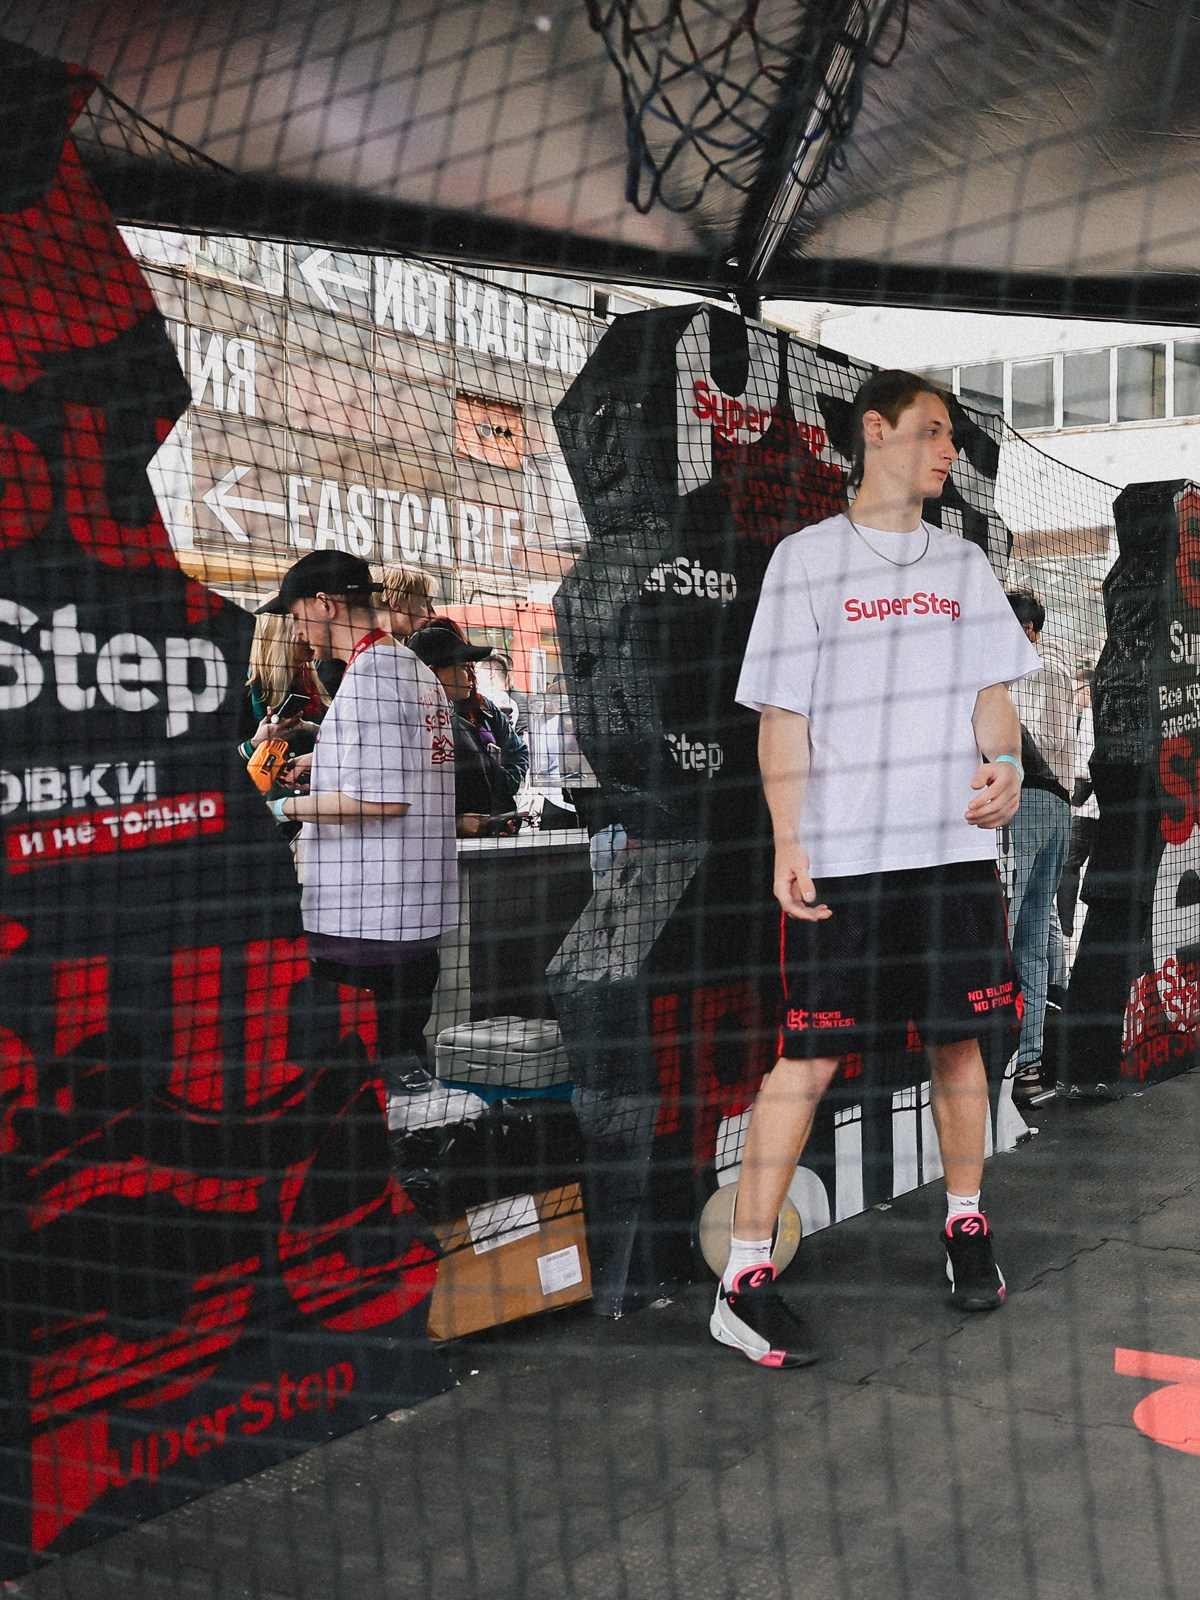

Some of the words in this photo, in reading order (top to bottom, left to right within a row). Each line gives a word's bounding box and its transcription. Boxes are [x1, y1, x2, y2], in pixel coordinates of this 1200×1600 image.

[639, 556, 738, 608] erStep
[844, 592, 961, 621] SuperStep
[1159, 685, 1182, 711] Все
[20, 832, 45, 856] и
[53, 822, 95, 849] не
[103, 799, 216, 838] только
[968, 990, 983, 1001] NO
[974, 1001, 989, 1012] NO
[992, 994, 1014, 1009] FOUL
[812, 1011, 841, 1019] KICKS
[107, 1361, 354, 1488] uperStep
